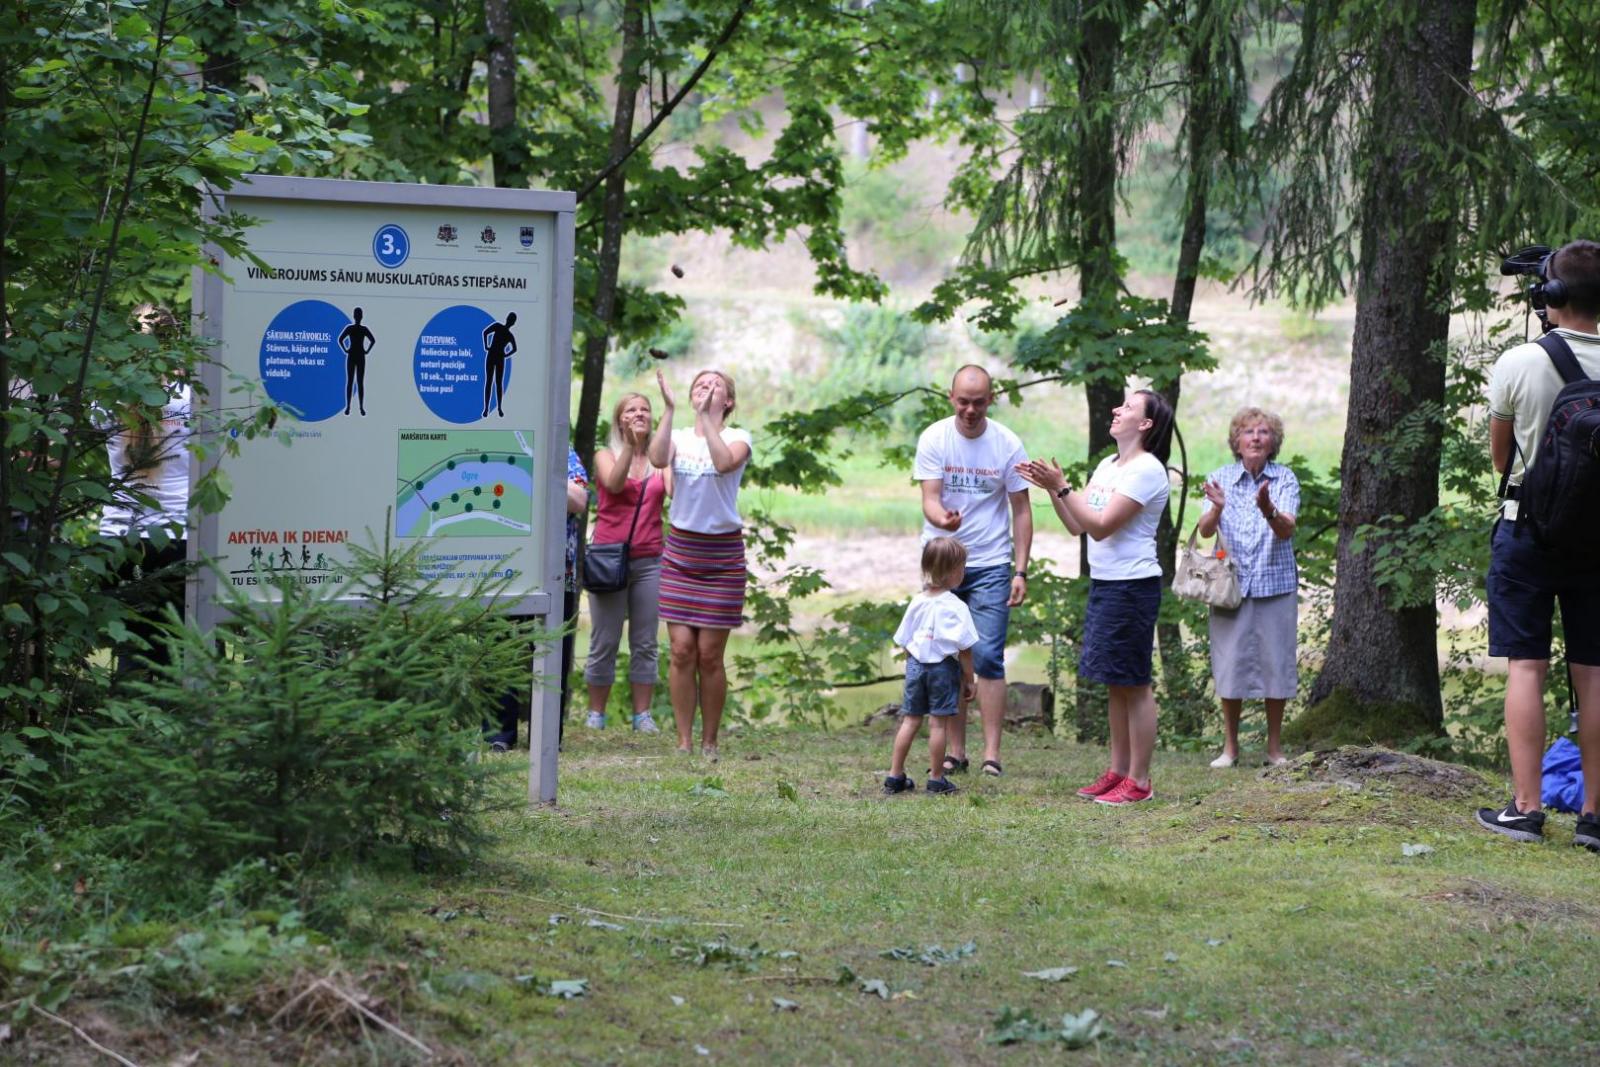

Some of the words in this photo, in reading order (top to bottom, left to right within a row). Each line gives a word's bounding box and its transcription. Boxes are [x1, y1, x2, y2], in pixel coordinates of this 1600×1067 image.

[382, 234, 401, 255] 3.
[247, 267, 327, 281] VINGROJUMS
[330, 269, 363, 283] SĀNU
[366, 272, 459, 287] MUSKULATŪRAS
[462, 275, 527, 289] STIEPŠANAI
[461, 471, 479, 482] Ogre
[228, 529, 279, 544] AKTĪVA
[283, 531, 297, 543] IK
[302, 530, 349, 544] DIENA!
[232, 577, 243, 585] TU
